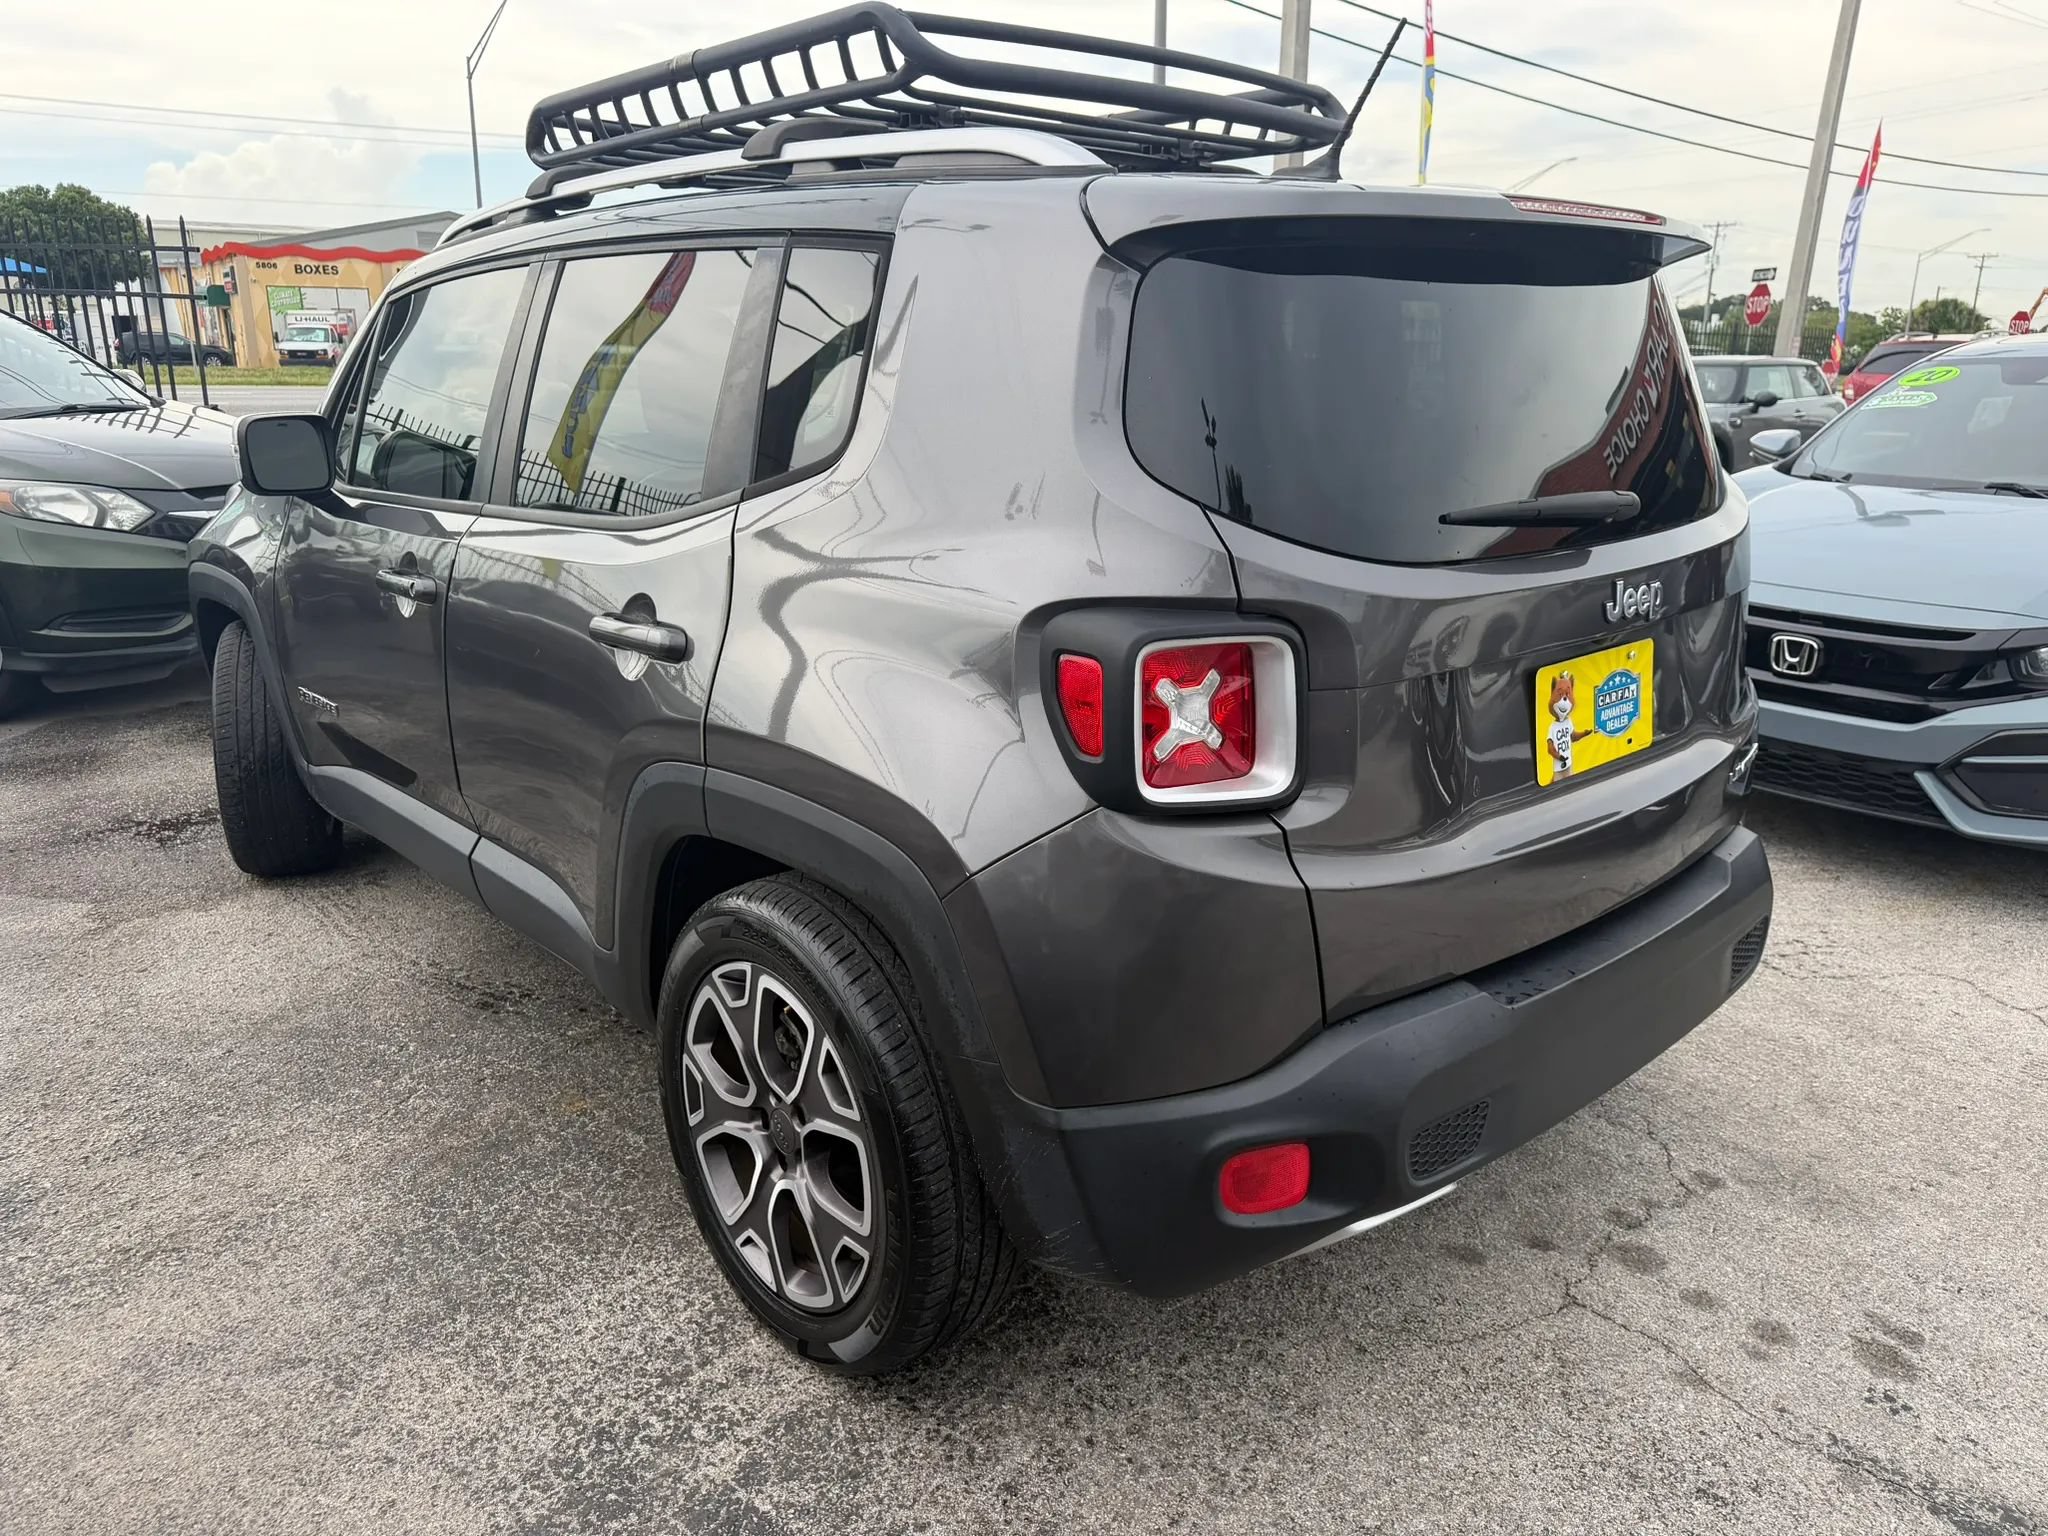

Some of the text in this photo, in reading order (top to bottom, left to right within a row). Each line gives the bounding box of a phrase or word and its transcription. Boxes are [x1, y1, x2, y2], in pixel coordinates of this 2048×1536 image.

[255, 262, 278, 270] 5806
[294, 264, 339, 275] BOXES
[1747, 296, 1769, 314] STOP
[2010, 320, 2030, 333] STOP
[1605, 579, 1663, 622] Jeep
[1598, 684, 1638, 707] CARFAX
[1600, 701, 1634, 721] ADVANTAGE
[1606, 715, 1628, 731] DEALER
[1556, 727, 1570, 741] CAR
[1557, 740, 1570, 753] FOX
